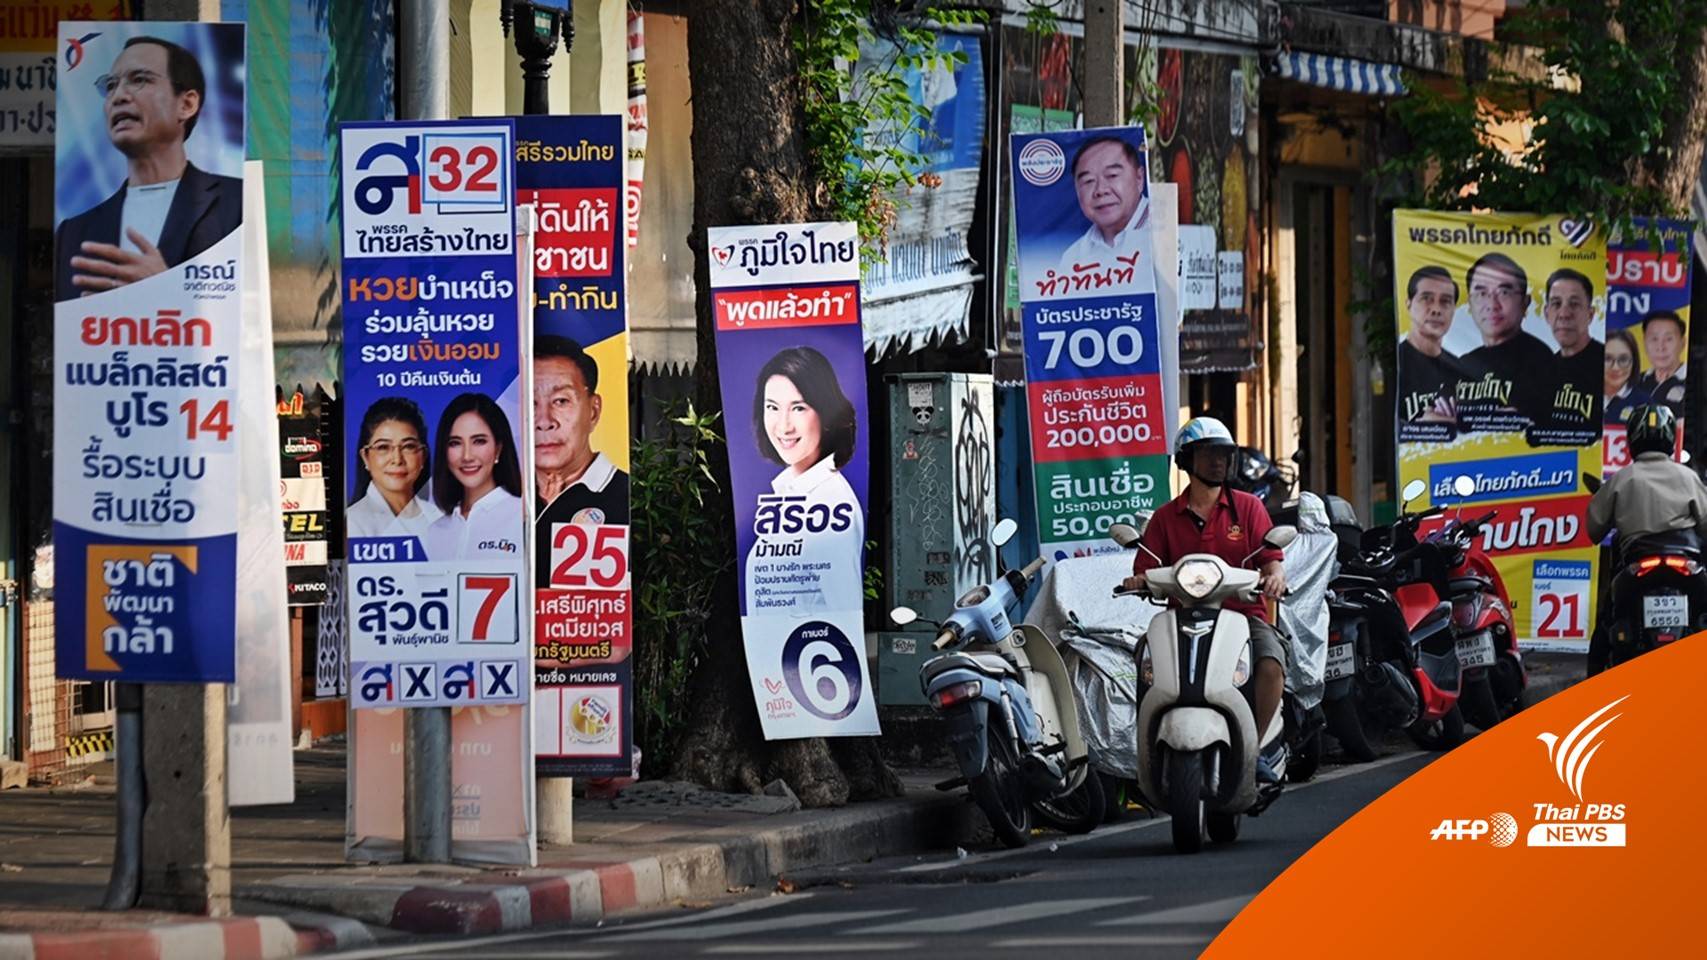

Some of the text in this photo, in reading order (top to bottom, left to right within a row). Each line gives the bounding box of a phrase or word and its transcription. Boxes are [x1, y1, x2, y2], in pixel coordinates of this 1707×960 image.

[428, 146, 498, 192] 32
[356, 227, 508, 253] ไทยสร้างไทย
[372, 224, 408, 234] พรรค
[1409, 222, 1552, 247] พรรคไทยภักดี
[740, 230, 854, 276] ภูมิใจไทย
[185, 259, 236, 280] กรณ์
[350, 270, 513, 301] หวยบำเหน็จ
[1036, 251, 1140, 297] ทำทันที
[81, 310, 212, 346] ยกเลิก
[365, 307, 494, 339] ร่วมลุ้นหวย
[1036, 302, 1143, 325] บัตรประชารัฐ
[361, 339, 500, 363] รวยเงินออม
[1038, 325, 1144, 369] 700
[66, 351, 229, 387] แบล็กลิสต์
[377, 369, 481, 387] 10 ปีคืนเงินต้น
[106, 392, 168, 438] บูโร
[179, 399, 233, 441] 14
[1044, 402, 1147, 425] ประกันชีวิต
[1046, 423, 1151, 449] 200,000
[82, 435, 206, 480] รื้อระบบ
[1051, 461, 1154, 499] สินเชื่อ
[91, 481, 195, 523] สินเชื่อ
[756, 496, 853, 534] สิริอร
[1054, 495, 1153, 514] ประกอบอาชีพ
[353, 540, 414, 561] เขต 1
[551, 525, 626, 587] 25
[755, 539, 803, 557] ม้ามณี
[103, 553, 174, 587] ชาติ
[357, 576, 403, 596] ดร.
[1535, 564, 1589, 577] เลือกพรรค
[103, 589, 174, 613] พัฒนา
[358, 588, 449, 645] สุวดี
[465, 577, 510, 640] 7
[1538, 592, 1584, 638] 21
[103, 615, 173, 654] กล้า
[545, 617, 623, 637] เตมียเวส
[569, 672, 617, 682] หมายเลข
[798, 640, 851, 715] 6
